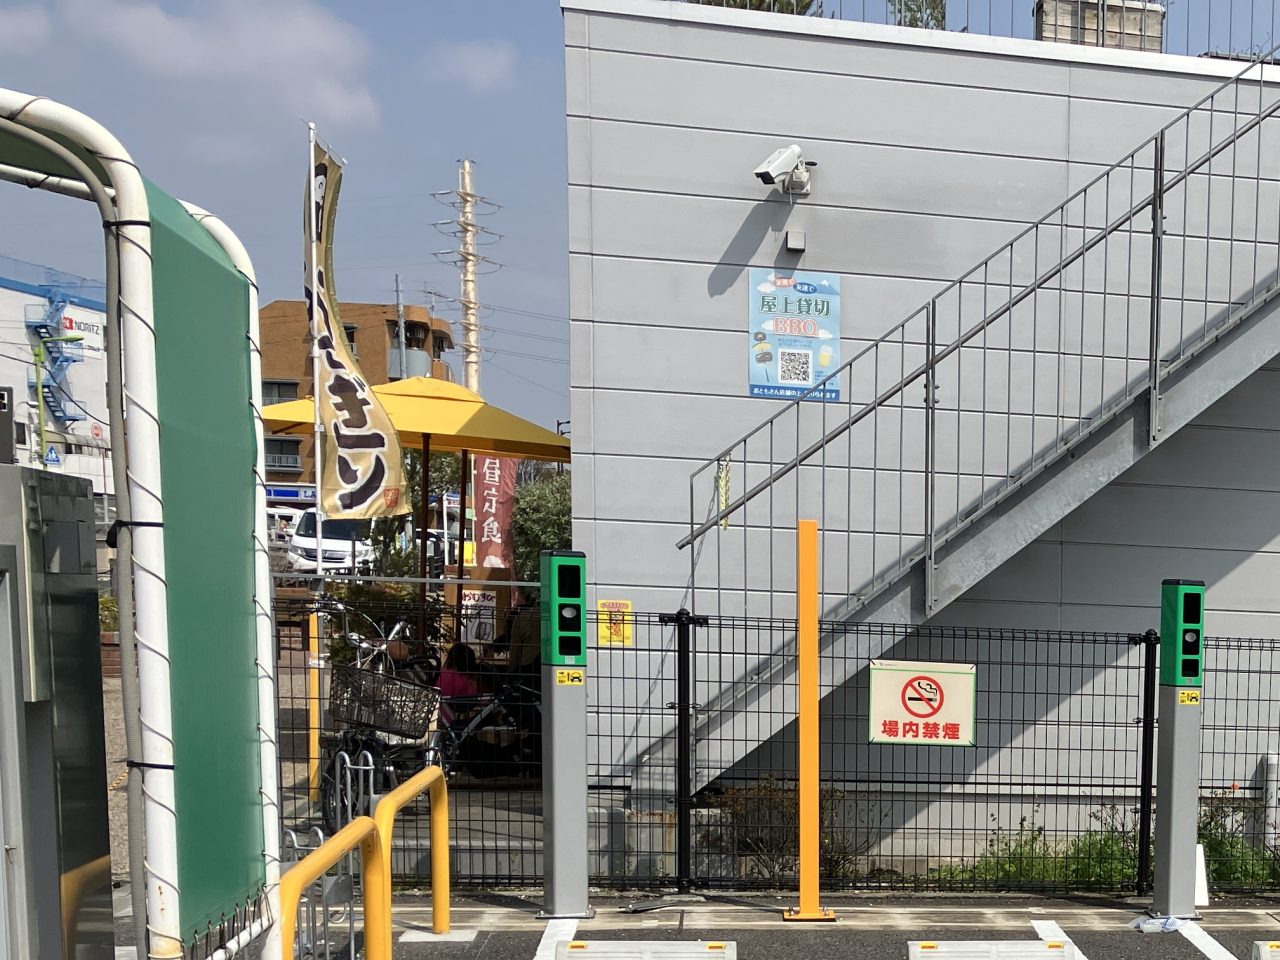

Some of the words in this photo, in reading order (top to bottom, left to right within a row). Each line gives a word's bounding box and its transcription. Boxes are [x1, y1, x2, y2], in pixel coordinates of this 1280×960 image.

[760, 296, 830, 316] 屋上貸切
[74, 320, 100, 335] NORITZ
[773, 317, 819, 337] BBQ
[882, 720, 960, 740] 場内禁煙
